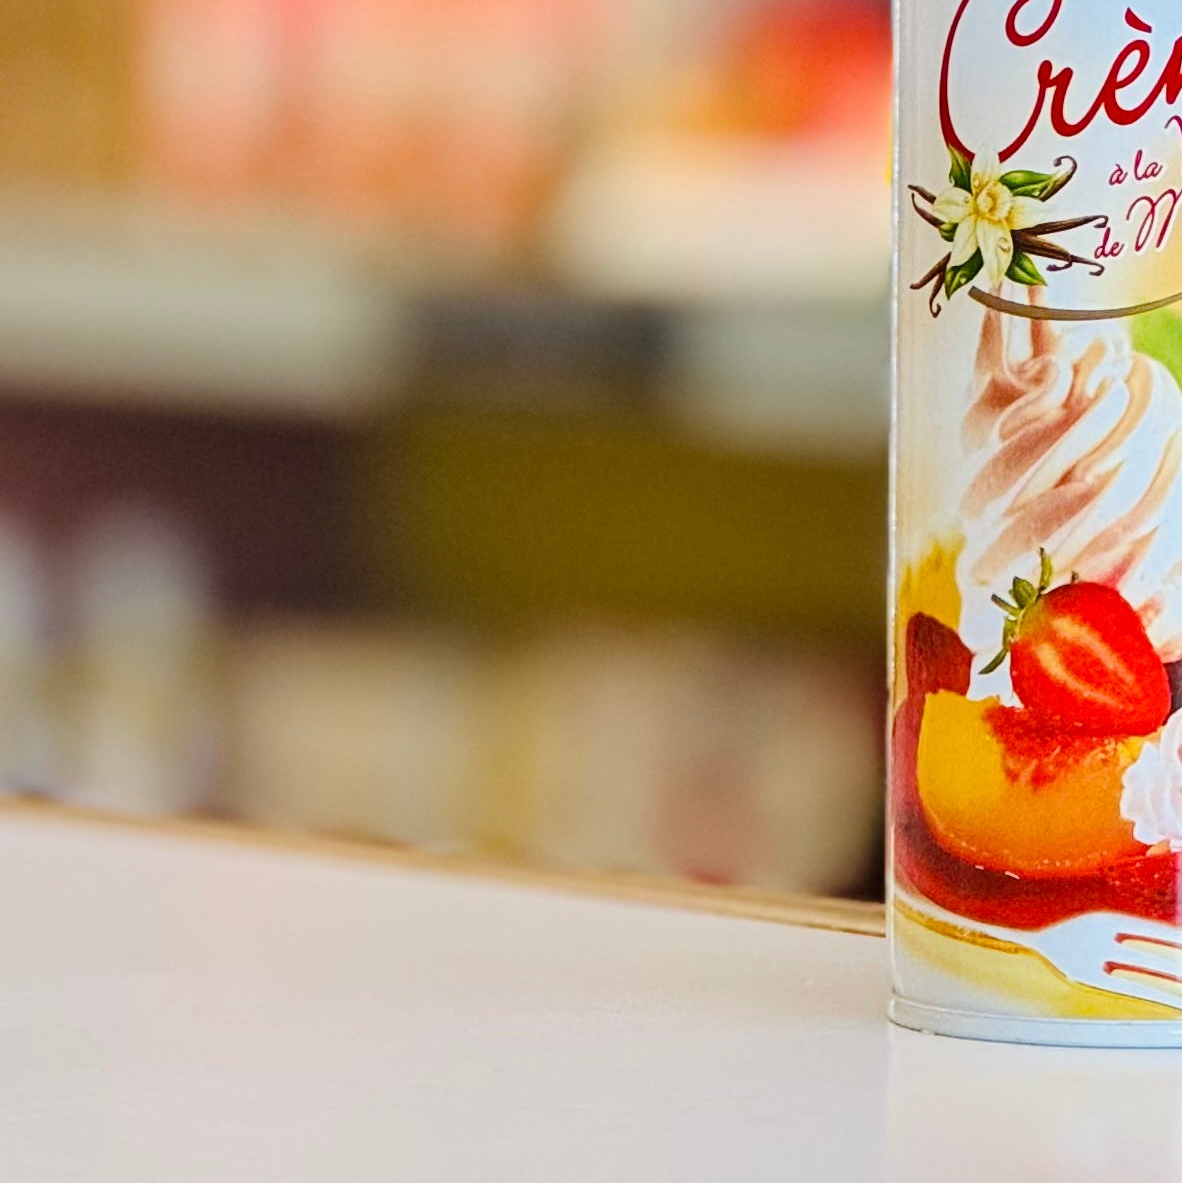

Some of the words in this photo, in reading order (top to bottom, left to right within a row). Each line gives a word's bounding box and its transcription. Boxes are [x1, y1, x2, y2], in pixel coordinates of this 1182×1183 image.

[1108, 163, 1127, 186] à
[1133, 149, 1162, 181] la
[1094, 228, 1125, 259] de
